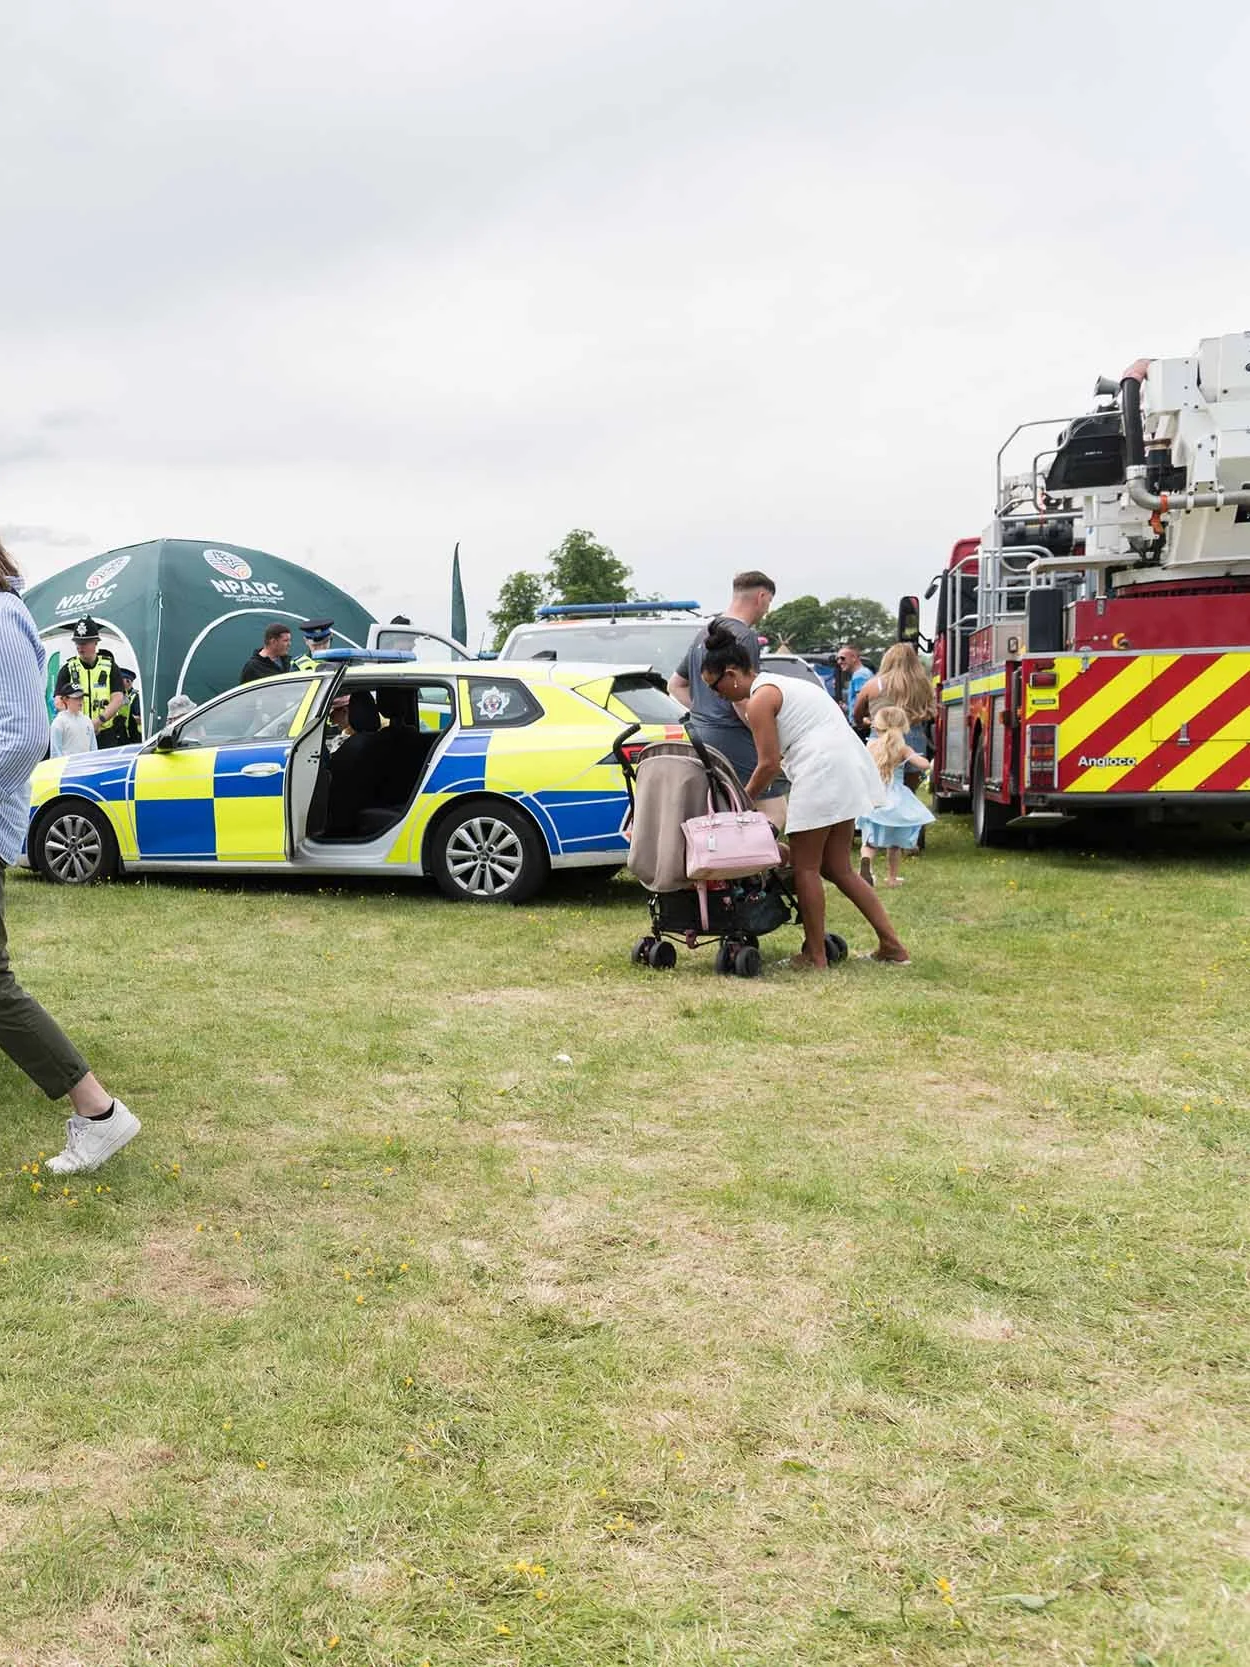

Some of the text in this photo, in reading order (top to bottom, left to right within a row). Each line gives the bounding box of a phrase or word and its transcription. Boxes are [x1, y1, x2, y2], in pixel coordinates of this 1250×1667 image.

[211, 579, 283, 596] NPARC
[56, 583, 118, 610] NPARC
[1077, 755, 1136, 767] Angloco
